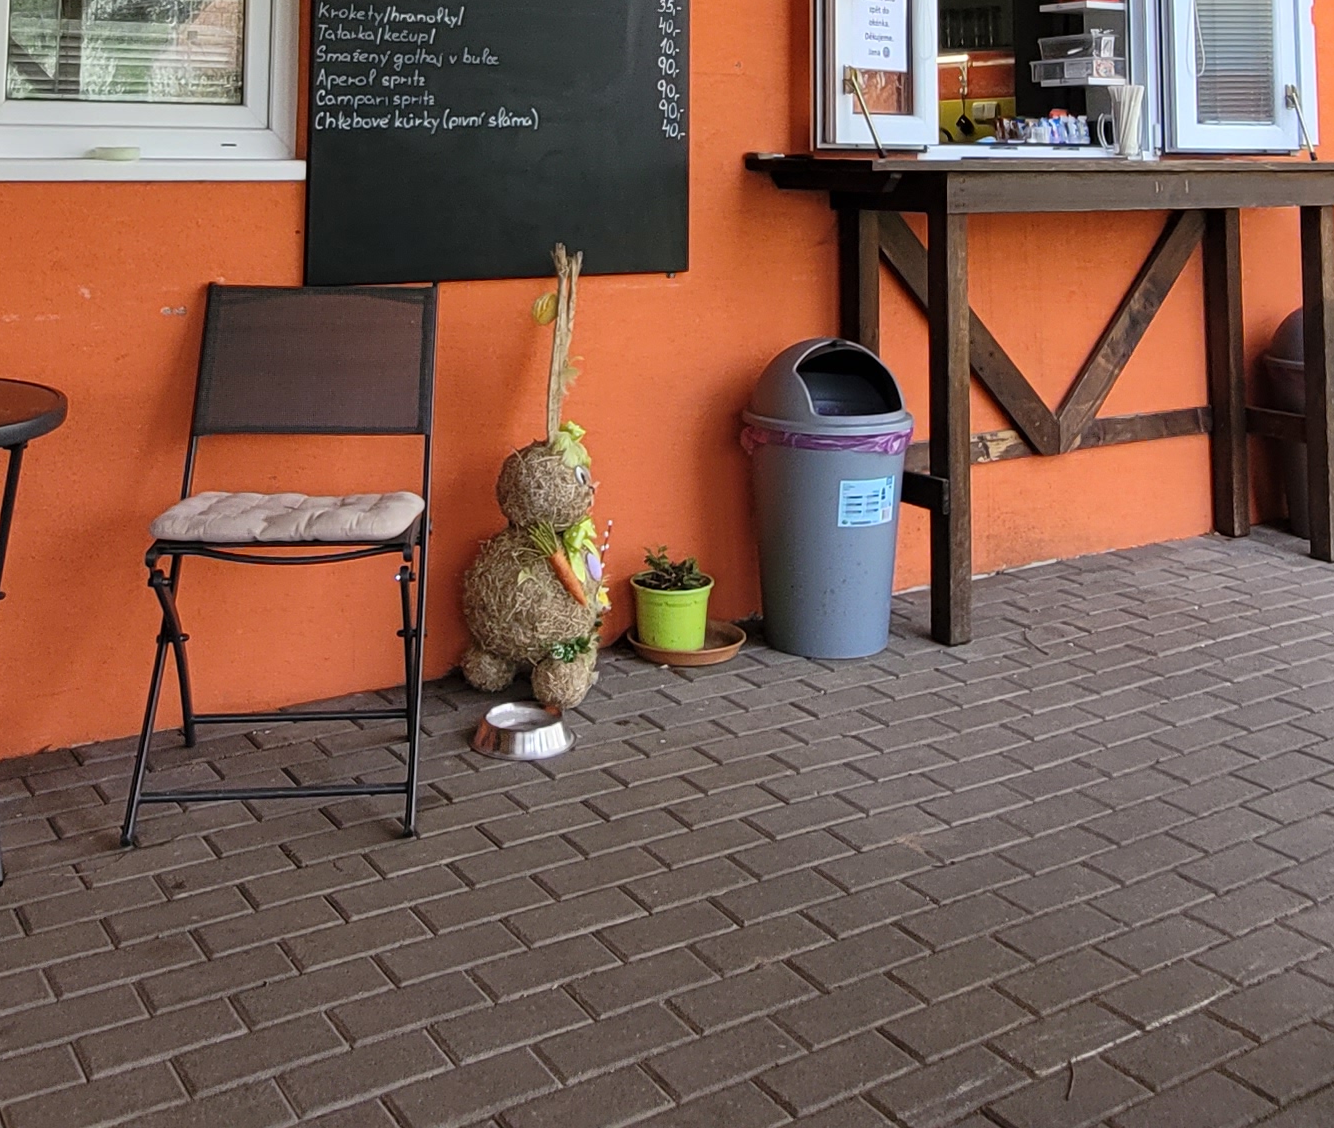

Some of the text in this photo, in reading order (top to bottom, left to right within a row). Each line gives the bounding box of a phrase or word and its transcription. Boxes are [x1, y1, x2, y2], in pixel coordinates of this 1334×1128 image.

[316, 45, 391, 68] Smažený
[393, 48, 443, 71] gothaj
[448, 54, 458, 65] v
[462, 47, 500, 66] bulce
[316, 68, 377, 90] Aperol
[381, 69, 426, 89] spritz
[316, 89, 388, 109] Campari
[393, 91, 435, 108] spritz
[315, 110, 391, 130] Chlebové
[394, 109, 441, 134] kůrky
[442, 108, 485, 130] (pivní
[487, 106, 539, 130] sláma)
